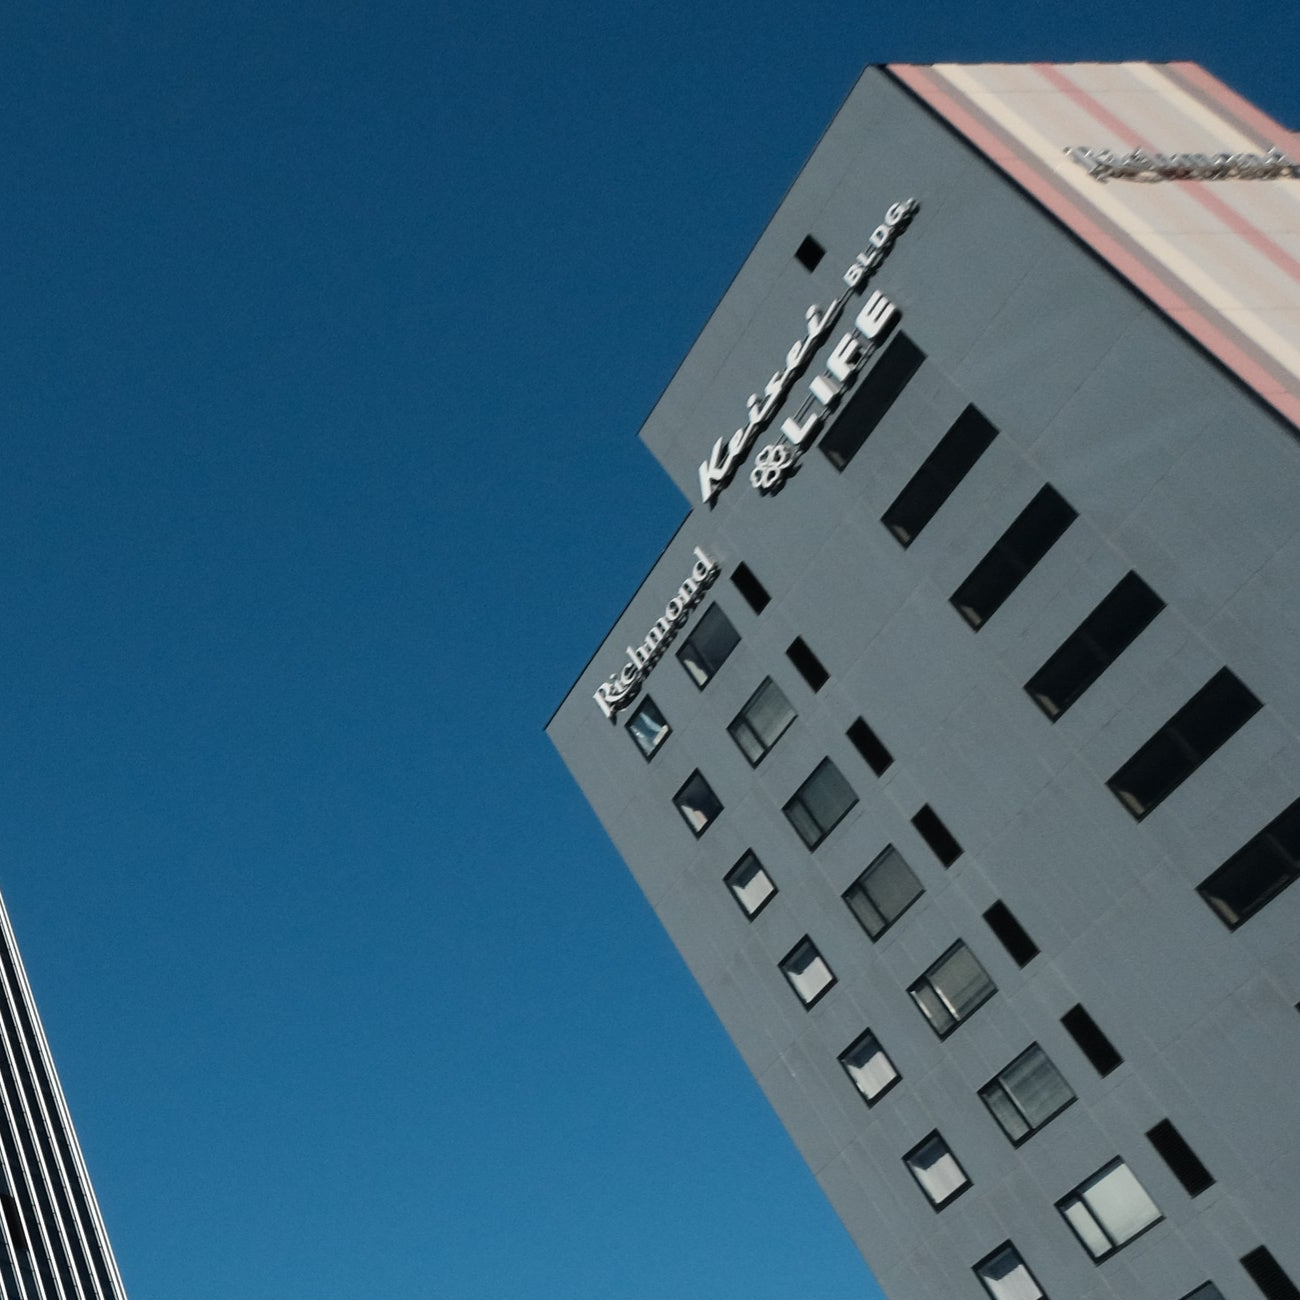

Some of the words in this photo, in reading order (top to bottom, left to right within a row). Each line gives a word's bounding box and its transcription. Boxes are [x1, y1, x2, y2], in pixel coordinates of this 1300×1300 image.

[699, 297, 840, 502] Keisei
[781, 289, 897, 445] LIFE
[593, 546, 720, 720] Richmond
